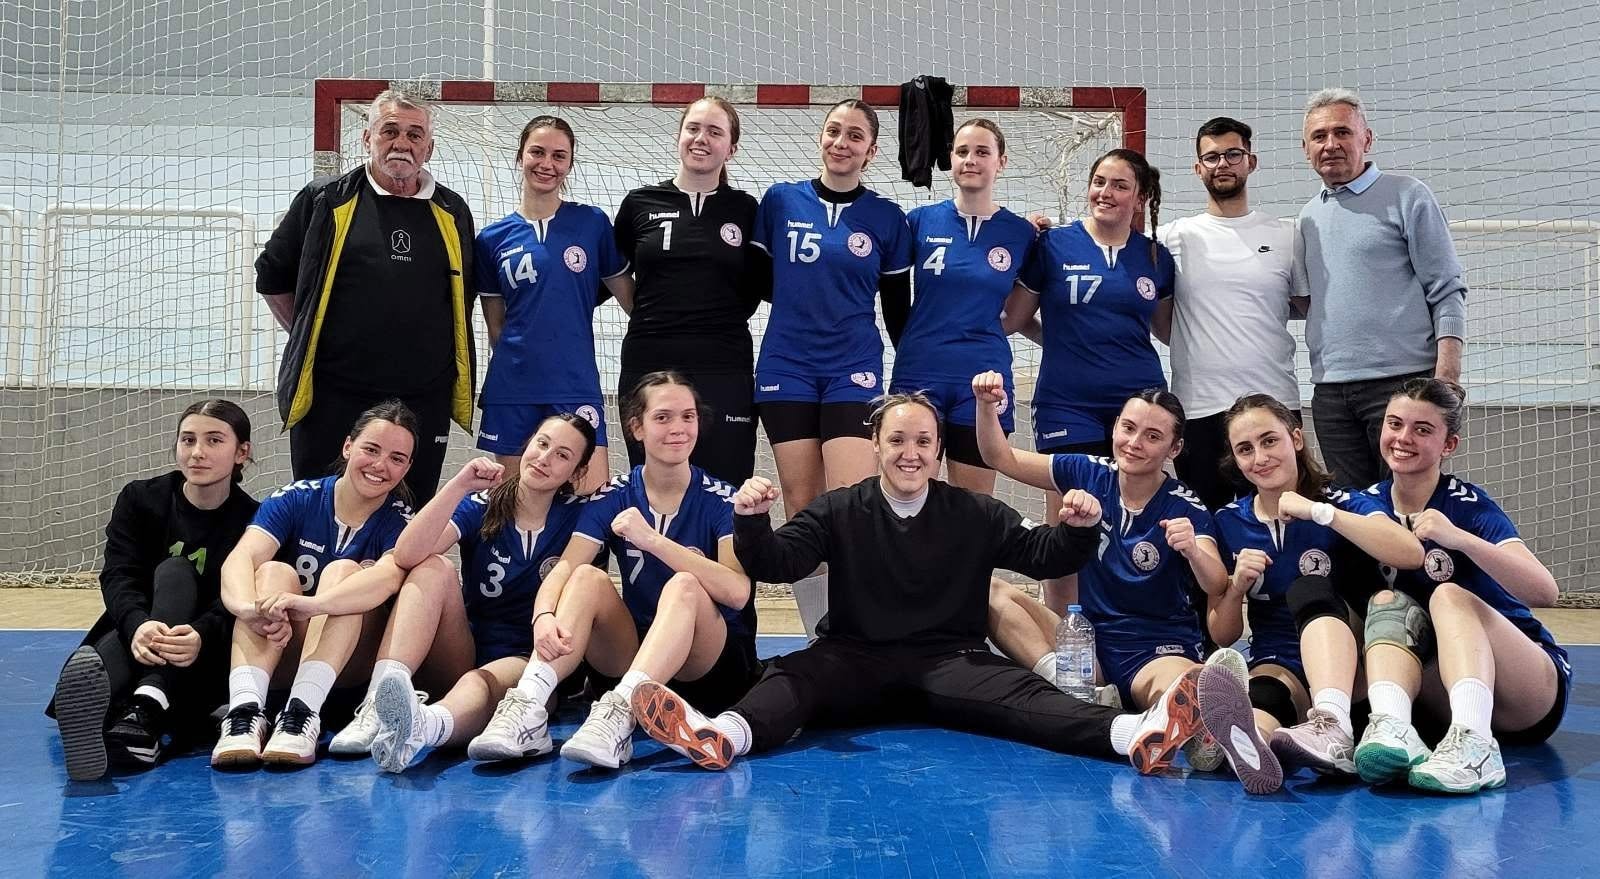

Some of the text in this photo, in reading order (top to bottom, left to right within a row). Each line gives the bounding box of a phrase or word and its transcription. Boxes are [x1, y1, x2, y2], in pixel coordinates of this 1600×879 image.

[659, 221, 673, 250] 1
[787, 220, 814, 229] hummel
[787, 231, 822, 263] 15
[926, 236, 953, 244] hummel
[501, 252, 538, 290] 14
[922, 246, 947, 275] 4
[1063, 263, 1090, 271] hummel
[1065, 275, 1103, 305] 17
[295, 554, 319, 592] 8
[479, 562, 506, 598] 3
[626, 549, 645, 585] 7
